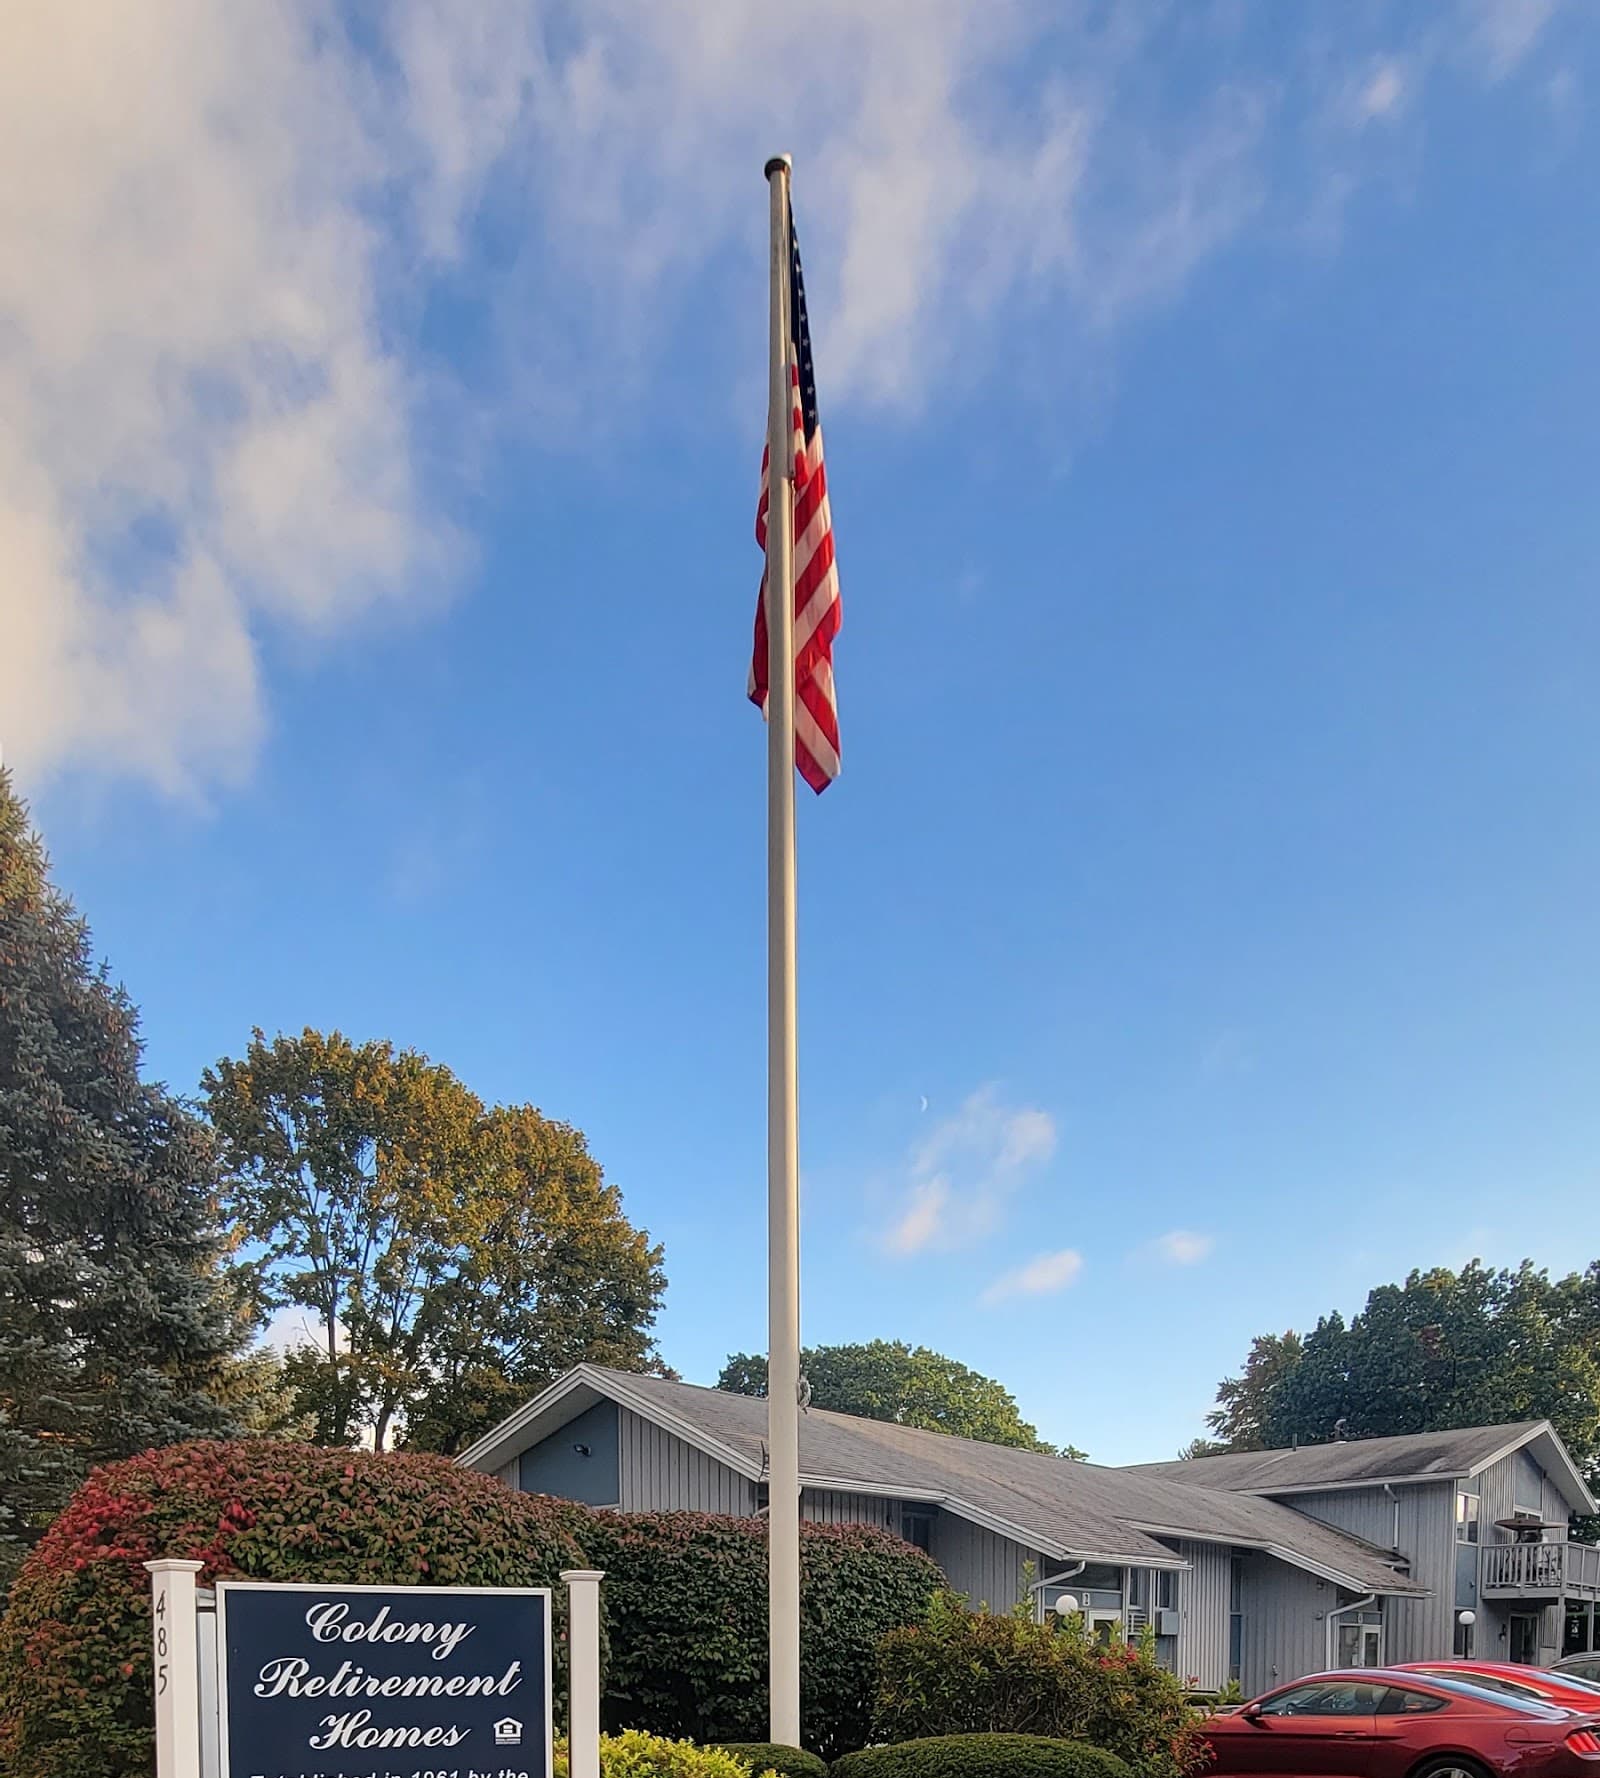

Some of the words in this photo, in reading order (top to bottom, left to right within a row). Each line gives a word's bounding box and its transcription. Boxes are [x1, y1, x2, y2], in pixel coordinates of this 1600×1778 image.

[155, 1589, 168, 1696] 485
[305, 1602, 477, 1660] Colony
[254, 1657, 522, 1698] Retirement
[309, 1708, 471, 1750] Homes
